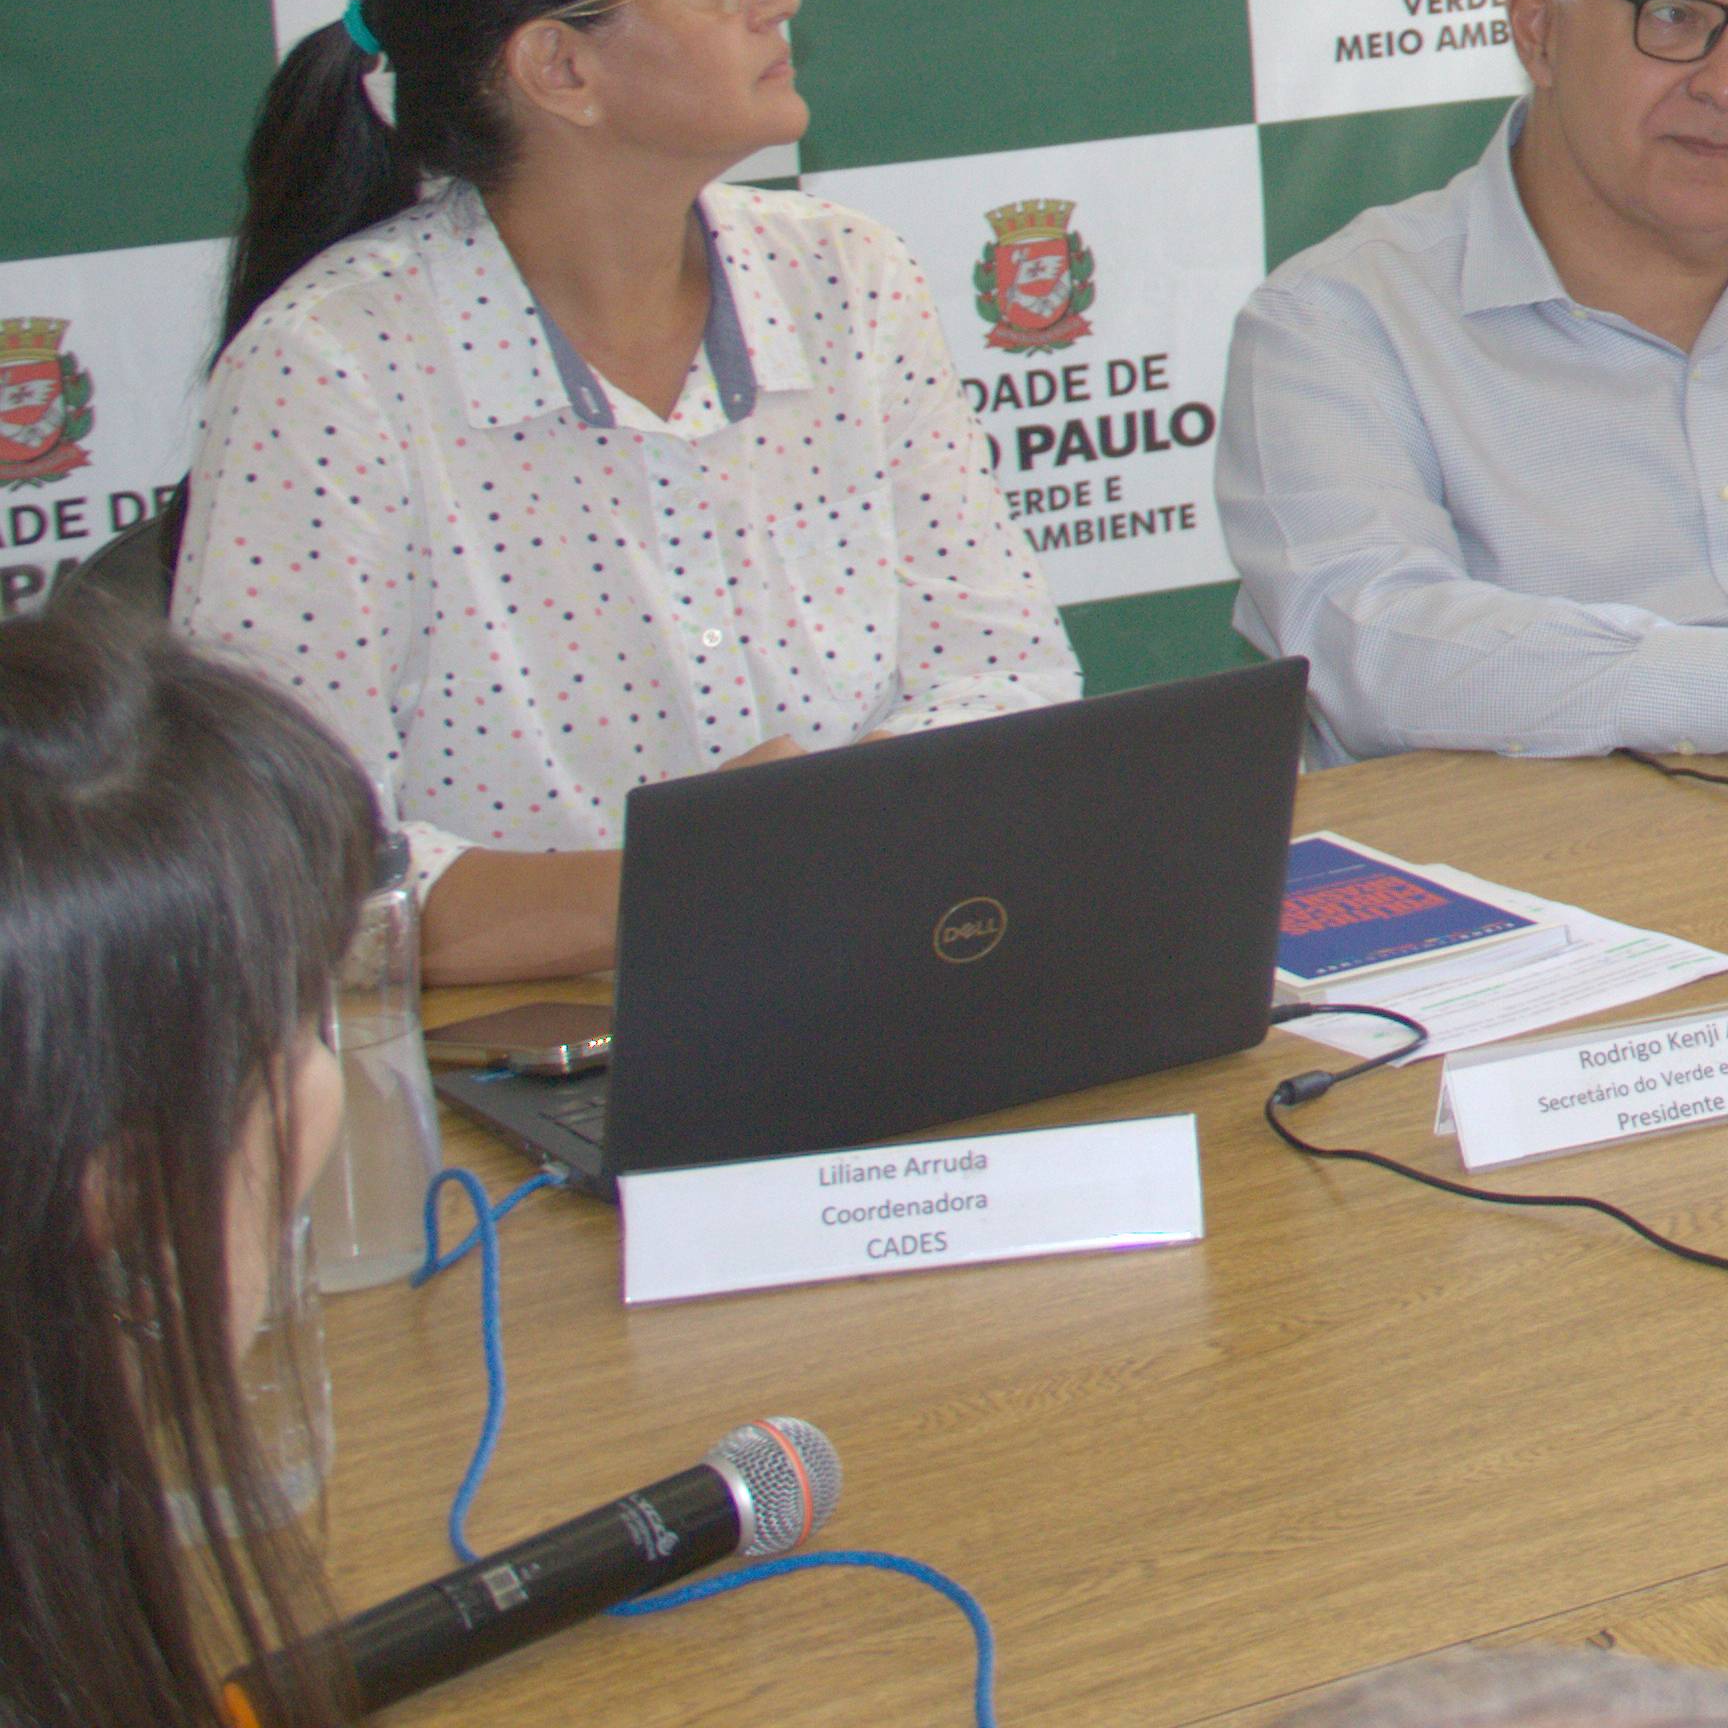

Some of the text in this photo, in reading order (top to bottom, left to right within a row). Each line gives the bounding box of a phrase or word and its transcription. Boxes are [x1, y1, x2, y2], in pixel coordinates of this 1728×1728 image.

[1336, 29, 1423, 62] MEIO
[961, 354, 1168, 413] DADE DE
[1016, 403, 1214, 471] PAULO
[1005, 476, 1121, 520] ERDE E
[1579, 1038, 1663, 1069] Rodrigo
[1667, 1024, 1720, 1051] Kenji
[1538, 1079, 1630, 1113] Secretário
[1634, 1074, 1658, 1094] do
[1662, 1059, 1715, 1088] Verde
[1617, 1094, 1726, 1131] Presidente
[819, 1150, 988, 1186] Liliane Arruda
[821, 1192, 988, 1226] Coordenadora
[866, 1231, 949, 1259] CADES
